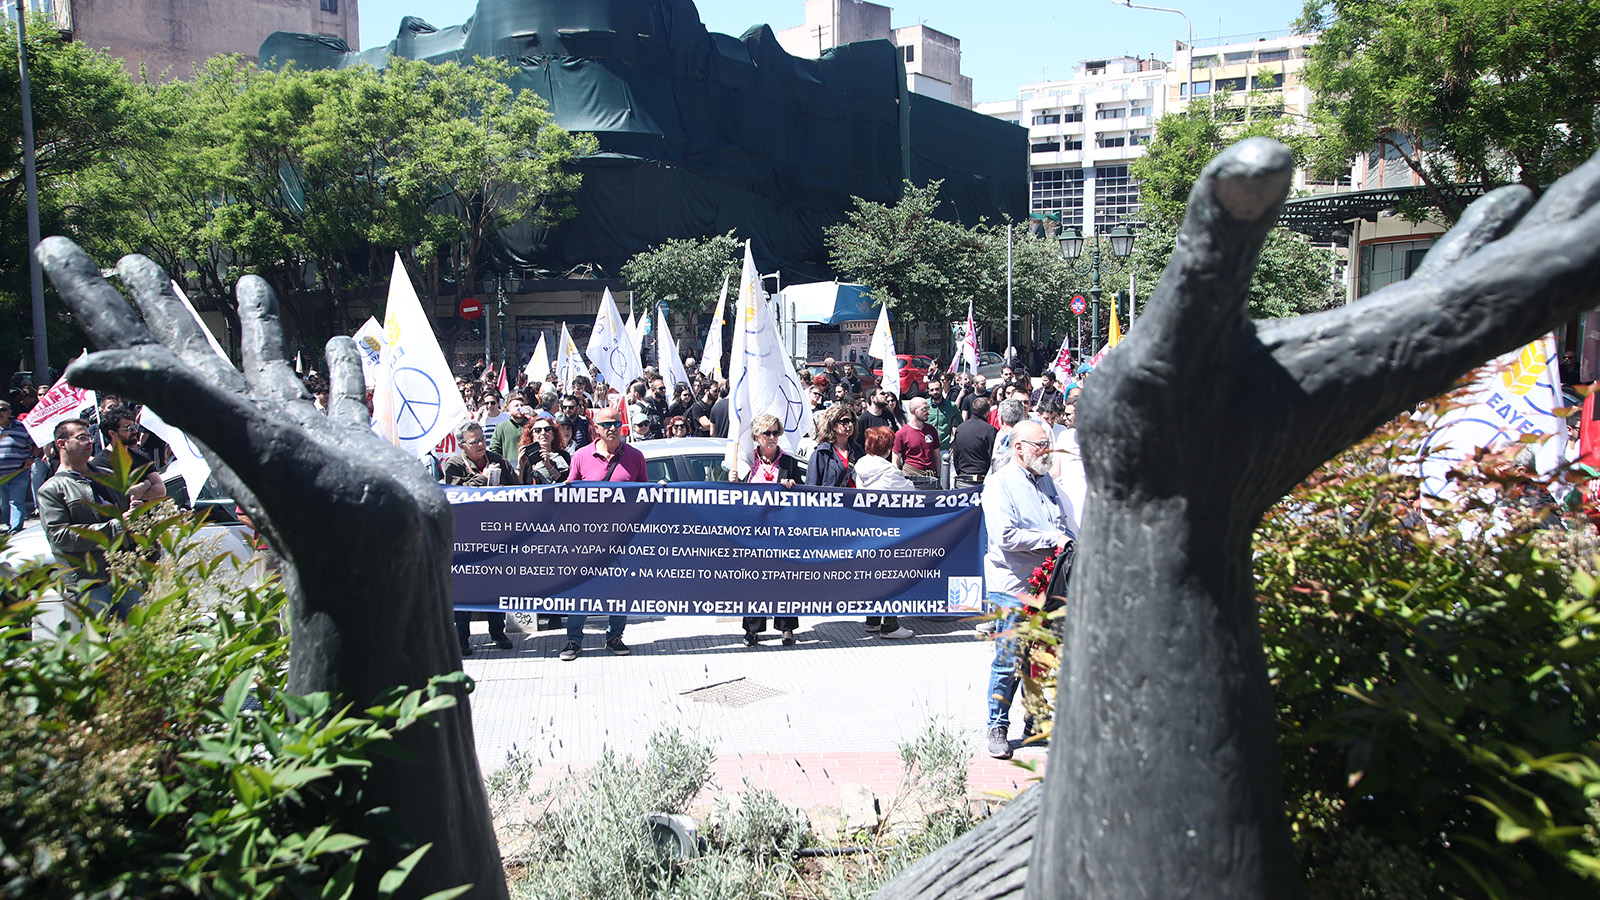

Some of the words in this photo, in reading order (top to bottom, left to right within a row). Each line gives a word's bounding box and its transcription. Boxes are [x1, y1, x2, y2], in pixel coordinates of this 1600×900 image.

[555, 488, 625, 502] ΗΜΕΡΑ
[636, 488, 843, 507] ΑΝΤΙΙΜΠΕΡΙΑΛΙΣΤΙΚΗΣ
[853, 493, 926, 507] ΔΡΑΣΗΣ
[935, 493, 981, 507] 2024
[481, 522, 501, 532] ΕΞΩ
[505, 522, 511, 530] Η
[516, 522, 555, 532] ΕΛΛΑΔΑ
[558, 524, 580, 532] ΑΠΟ
[583, 524, 608, 532] ΤΟΥΣ
[612, 524, 680, 534] ΠΟΛΕΜΙΚΟΥΣ
[683, 524, 751, 536] ΣΧΕΔΙΑΣΜΟΥΣ
[755, 526, 770, 536] ΚΑΙ
[773, 526, 785, 536] ΤΑ
[788, 526, 828, 536] ΣΦΑΓΕΙΑ
[454, 542, 507, 554] ΠΙΣΤΡΕΨΕΙ
[511, 544, 518, 554] Η
[522, 544, 568, 554] ΦΡΕΓΑΤΑ
[610, 544, 625, 554] ΚΑΙ
[629, 546, 655, 556] ΟΛΕΣ
[658, 546, 668, 556] ΟΙ
[672, 546, 729, 558] ΕΛΛΗΝΙΚΕΣ
[733, 548, 801, 558] ΣΤΡΑΤΙΩΤΙΚΕΣ
[803, 550, 853, 558] ΔΥΝΑΜΕΙΣ
[856, 548, 876, 558] ΑΠΟ
[879, 548, 891, 558] ΤΟ
[894, 548, 945, 558] ΕΞΩΤΕΡΙΚΟ
[451, 564, 502, 574] ΚΛΕΙΣΟΥΝ
[506, 566, 516, 576] ΟΙ
[520, 566, 554, 576] ΒΑΣΕΙΣ
[558, 566, 577, 576] ΤΟΥ
[581, 566, 628, 576] ΘΑΝΑΤΟΥ
[640, 568, 653, 578] ΝΑ
[657, 568, 694, 578] ΚΛΕΙΣΕΙ
[698, 570, 711, 580] ΤΟ
[715, 568, 759, 580] ΝΑΤΟΪΚΟ
[762, 570, 820, 580] ΣΤΡΑΤΗΓΕΙΟ
[824, 570, 851, 580] NRDC
[854, 570, 871, 580] ΣΤΗ
[875, 570, 940, 580] ΘΕΣΣΑΛΟΝΙΚΗ
[499, 597, 575, 611] ΕΠΙΤΡΟΠΗ
[580, 599, 603, 611] ΓΙΑ
[607, 600, 626, 612] ΤΗ
[630, 600, 688, 612] ΔΙΕΘΝΗ
[693, 601, 743, 613] ΥΦΕΣΗ
[748, 602, 772, 613] ΚΑΙ
[777, 602, 832, 613] ΕΙΡΗΝΗ
[836, 601, 945, 613] ΘΕΣΣΑΛΟΝΙΚΗΣ
